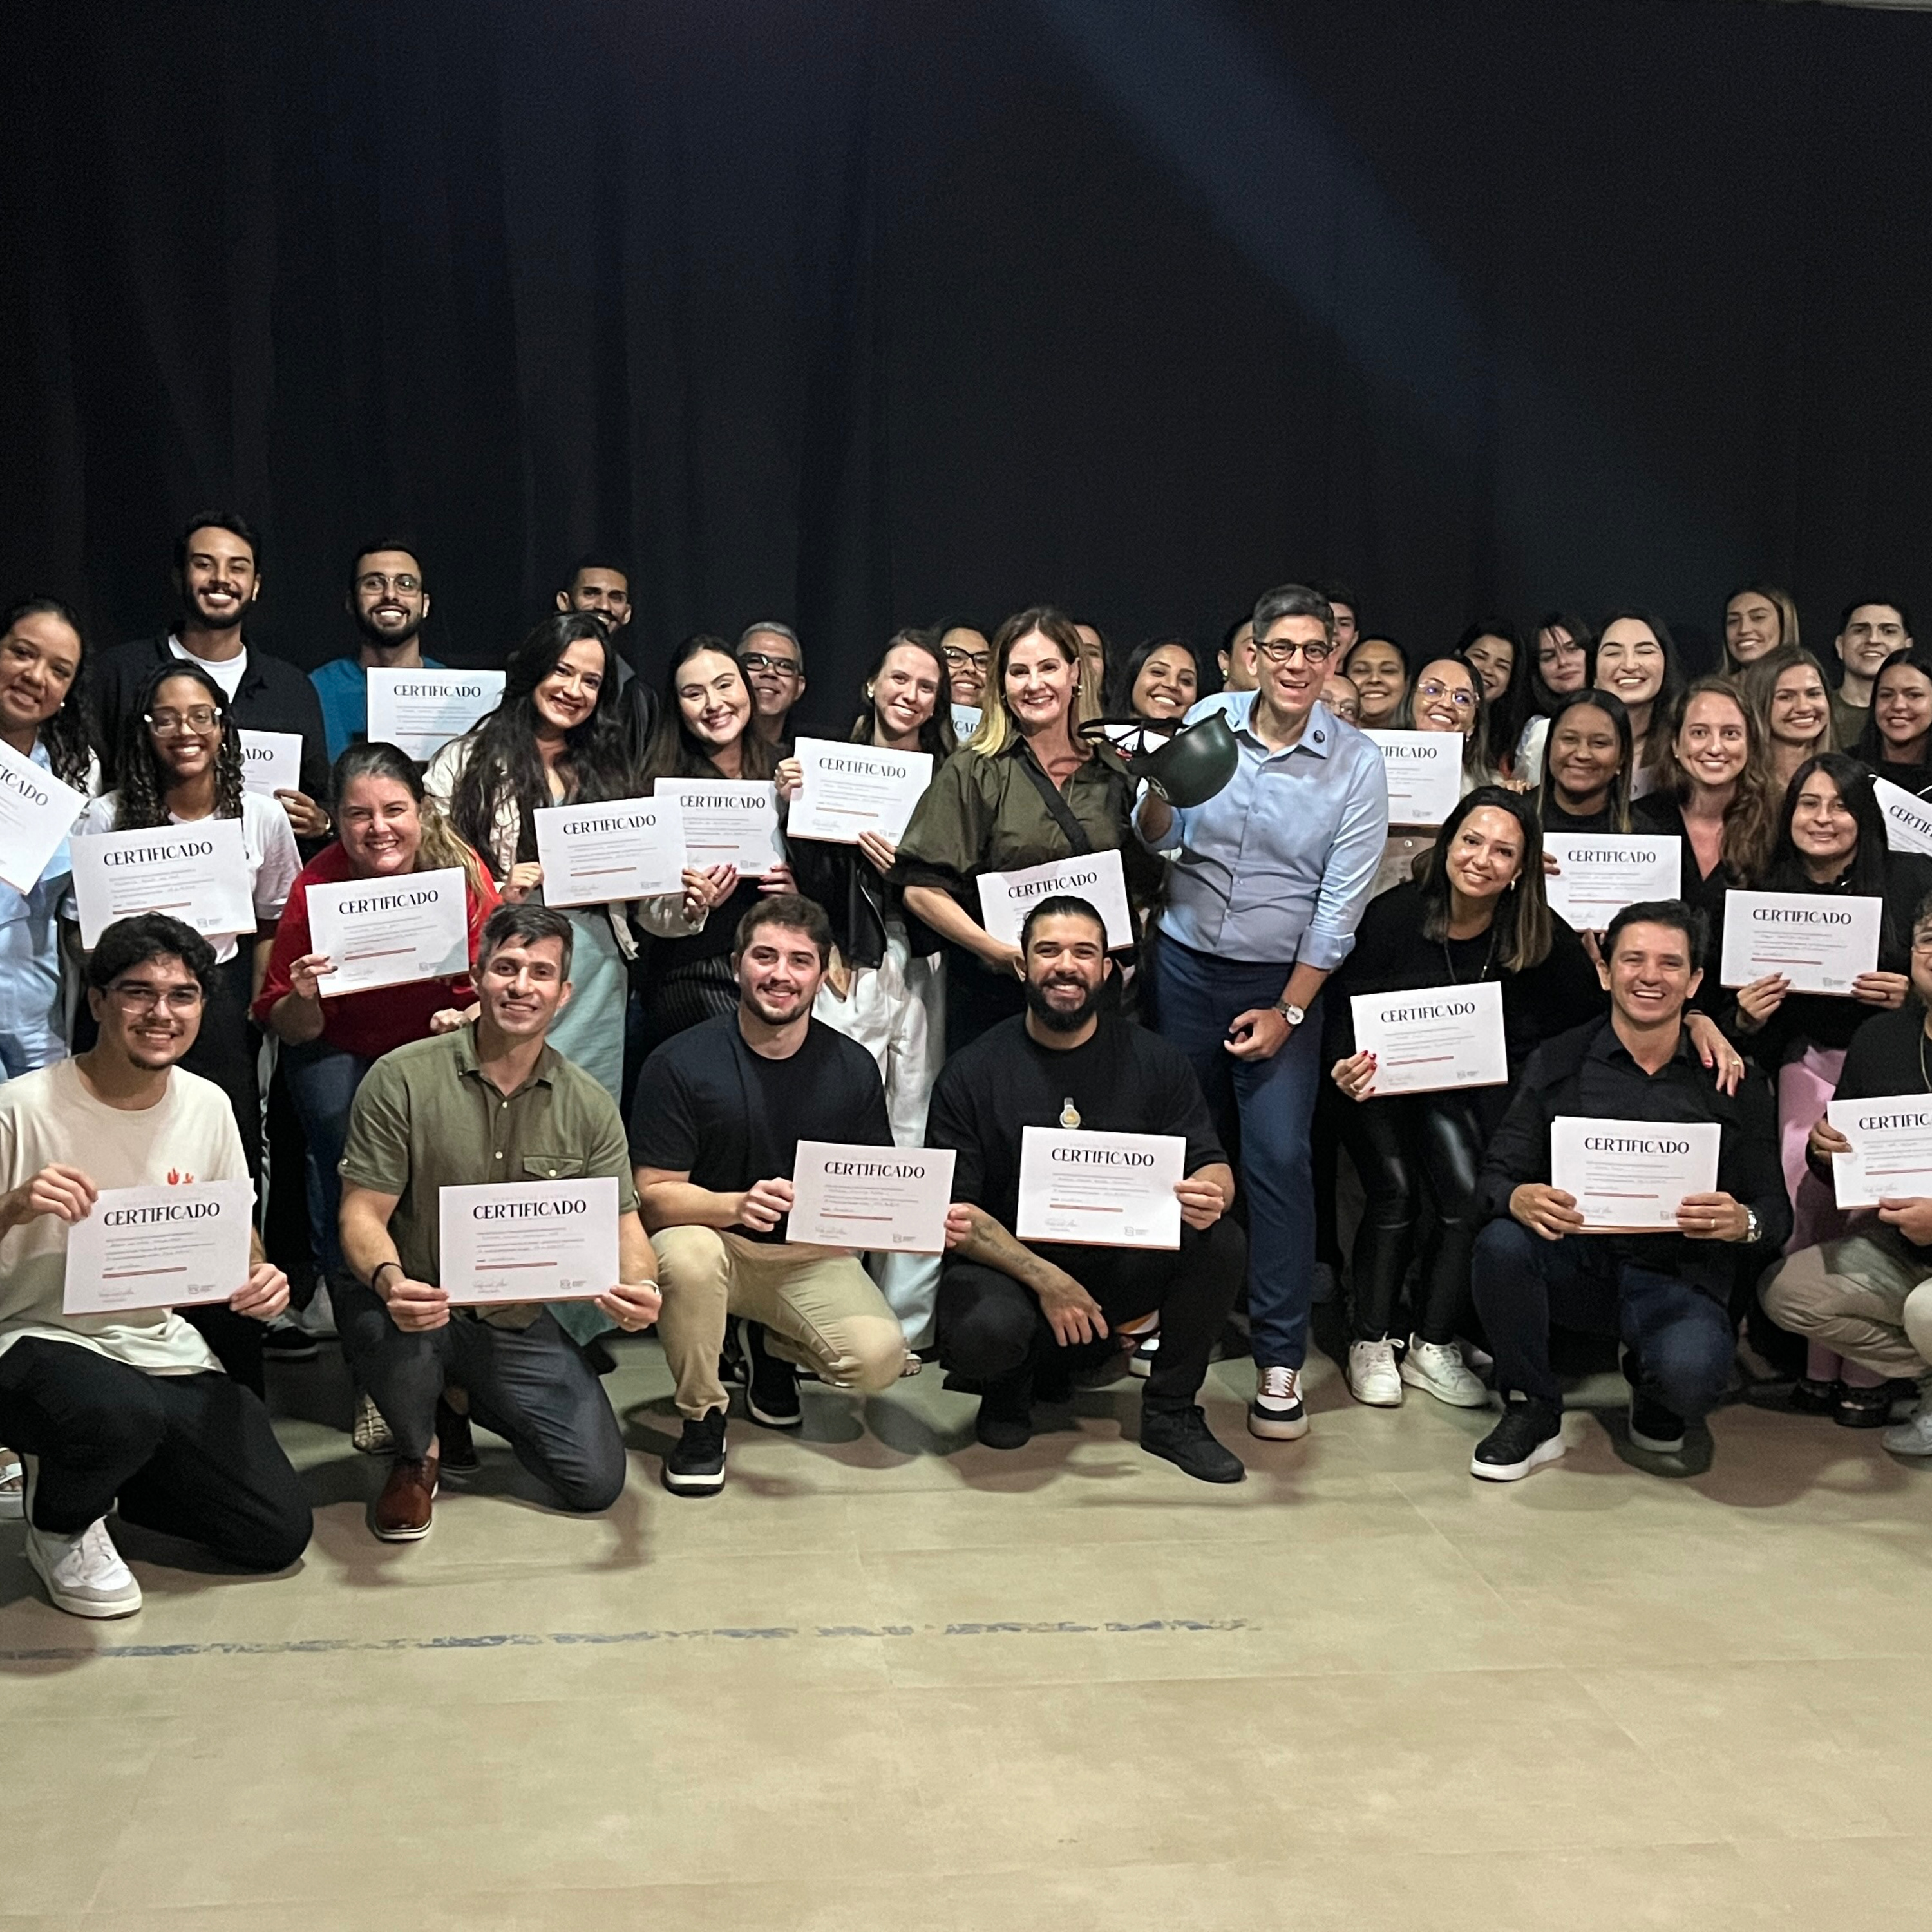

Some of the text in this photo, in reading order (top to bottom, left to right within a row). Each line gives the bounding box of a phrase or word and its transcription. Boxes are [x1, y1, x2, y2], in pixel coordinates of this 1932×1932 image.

[393, 685, 482, 698] CERTIFICADO
[819, 757, 906, 779] CERTIFICADO
[0, 764, 48, 806] ICADO
[679, 795, 766, 809] CERTIFICADO
[563, 815, 656, 835] CERTIFICADO
[1889, 805, 1932, 837] CERTIF
[103, 841, 213, 866] CERTIFICADO
[1567, 849, 1656, 863] CERTIFICADO
[1007, 871, 1097, 899] CERTIFICADO
[339, 889, 439, 914] CERTIFICADO
[1752, 909, 1852, 925] CERTIFICADO
[1381, 1002, 1475, 1023] CERTIFICADO
[1859, 1113, 1932, 1130] CERTIFIC
[1584, 1137, 1690, 1155] CERTIFICADO
[1051, 1148, 1155, 1167] CERTIFICADO
[824, 1161, 925, 1179] CERTIFICADO
[104, 1202, 220, 1226] CERTIFICADO
[473, 1199, 587, 1220] CERTIFICADO
